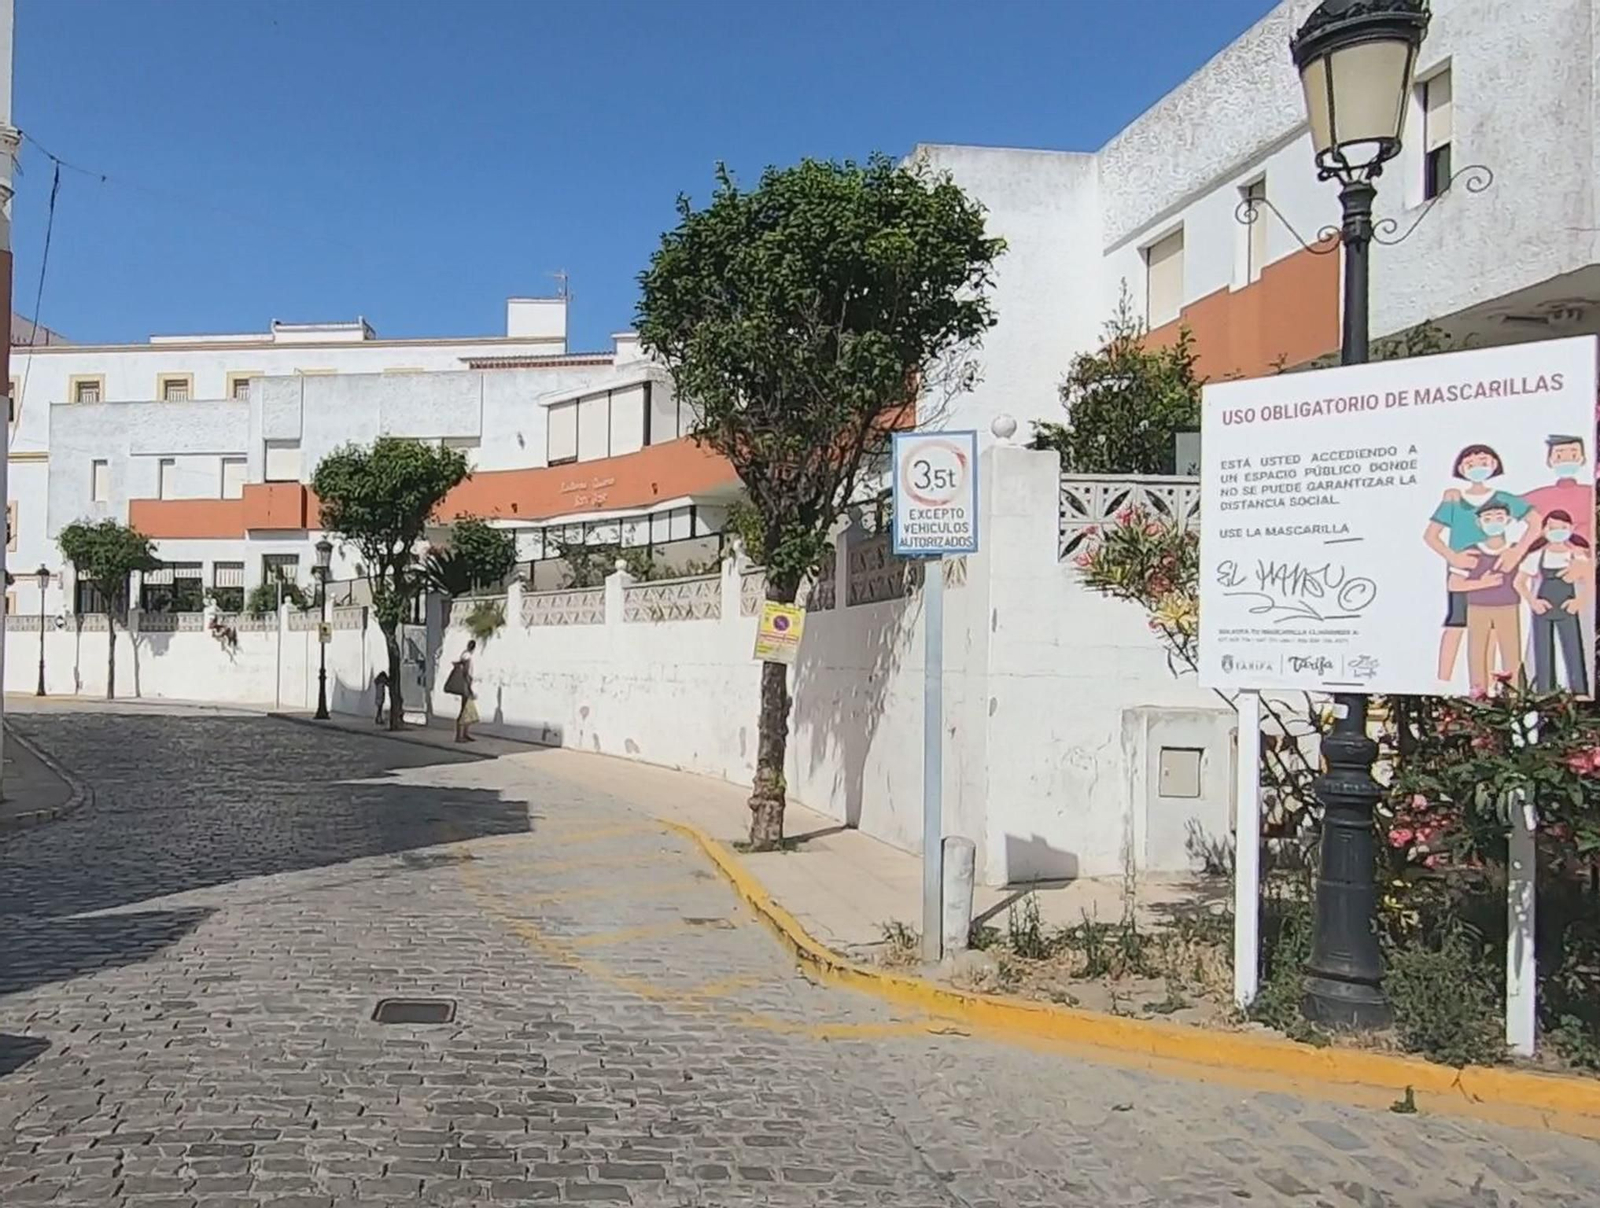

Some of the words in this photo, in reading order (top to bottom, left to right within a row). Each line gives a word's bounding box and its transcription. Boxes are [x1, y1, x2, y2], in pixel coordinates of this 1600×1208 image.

[1222, 408, 1255, 426] USO
[1260, 394, 1379, 422] OBLIGATORIO
[1385, 391, 1409, 408] DE
[1414, 373, 1564, 406] MASCARILLAS
[1260, 454, 1301, 467] USTED
[1311, 446, 1397, 463] ACCEDIENDO
[1408, 444, 1418, 455] A
[1220, 474, 1238, 484] UN
[1244, 469, 1297, 482] ESPACIO
[1369, 459, 1418, 473] DONDE
[1220, 487, 1238, 497] NO
[1242, 486, 1257, 496] SE
[1261, 482, 1302, 495] PUEDE
[1306, 476, 1395, 492] GARANTIZAR
[1399, 474, 1417, 485] LA
[1220, 499, 1286, 511] DISTANCIA
[909, 508, 964, 520] EXCEPTO
[904, 522, 969, 534] VEHICULOS
[1219, 528, 1243, 538] USE
[1246, 528, 1261, 538] LA
[1264, 523, 1350, 537] MASCARILLA
[900, 536, 973, 548] AUTORIZADOS
